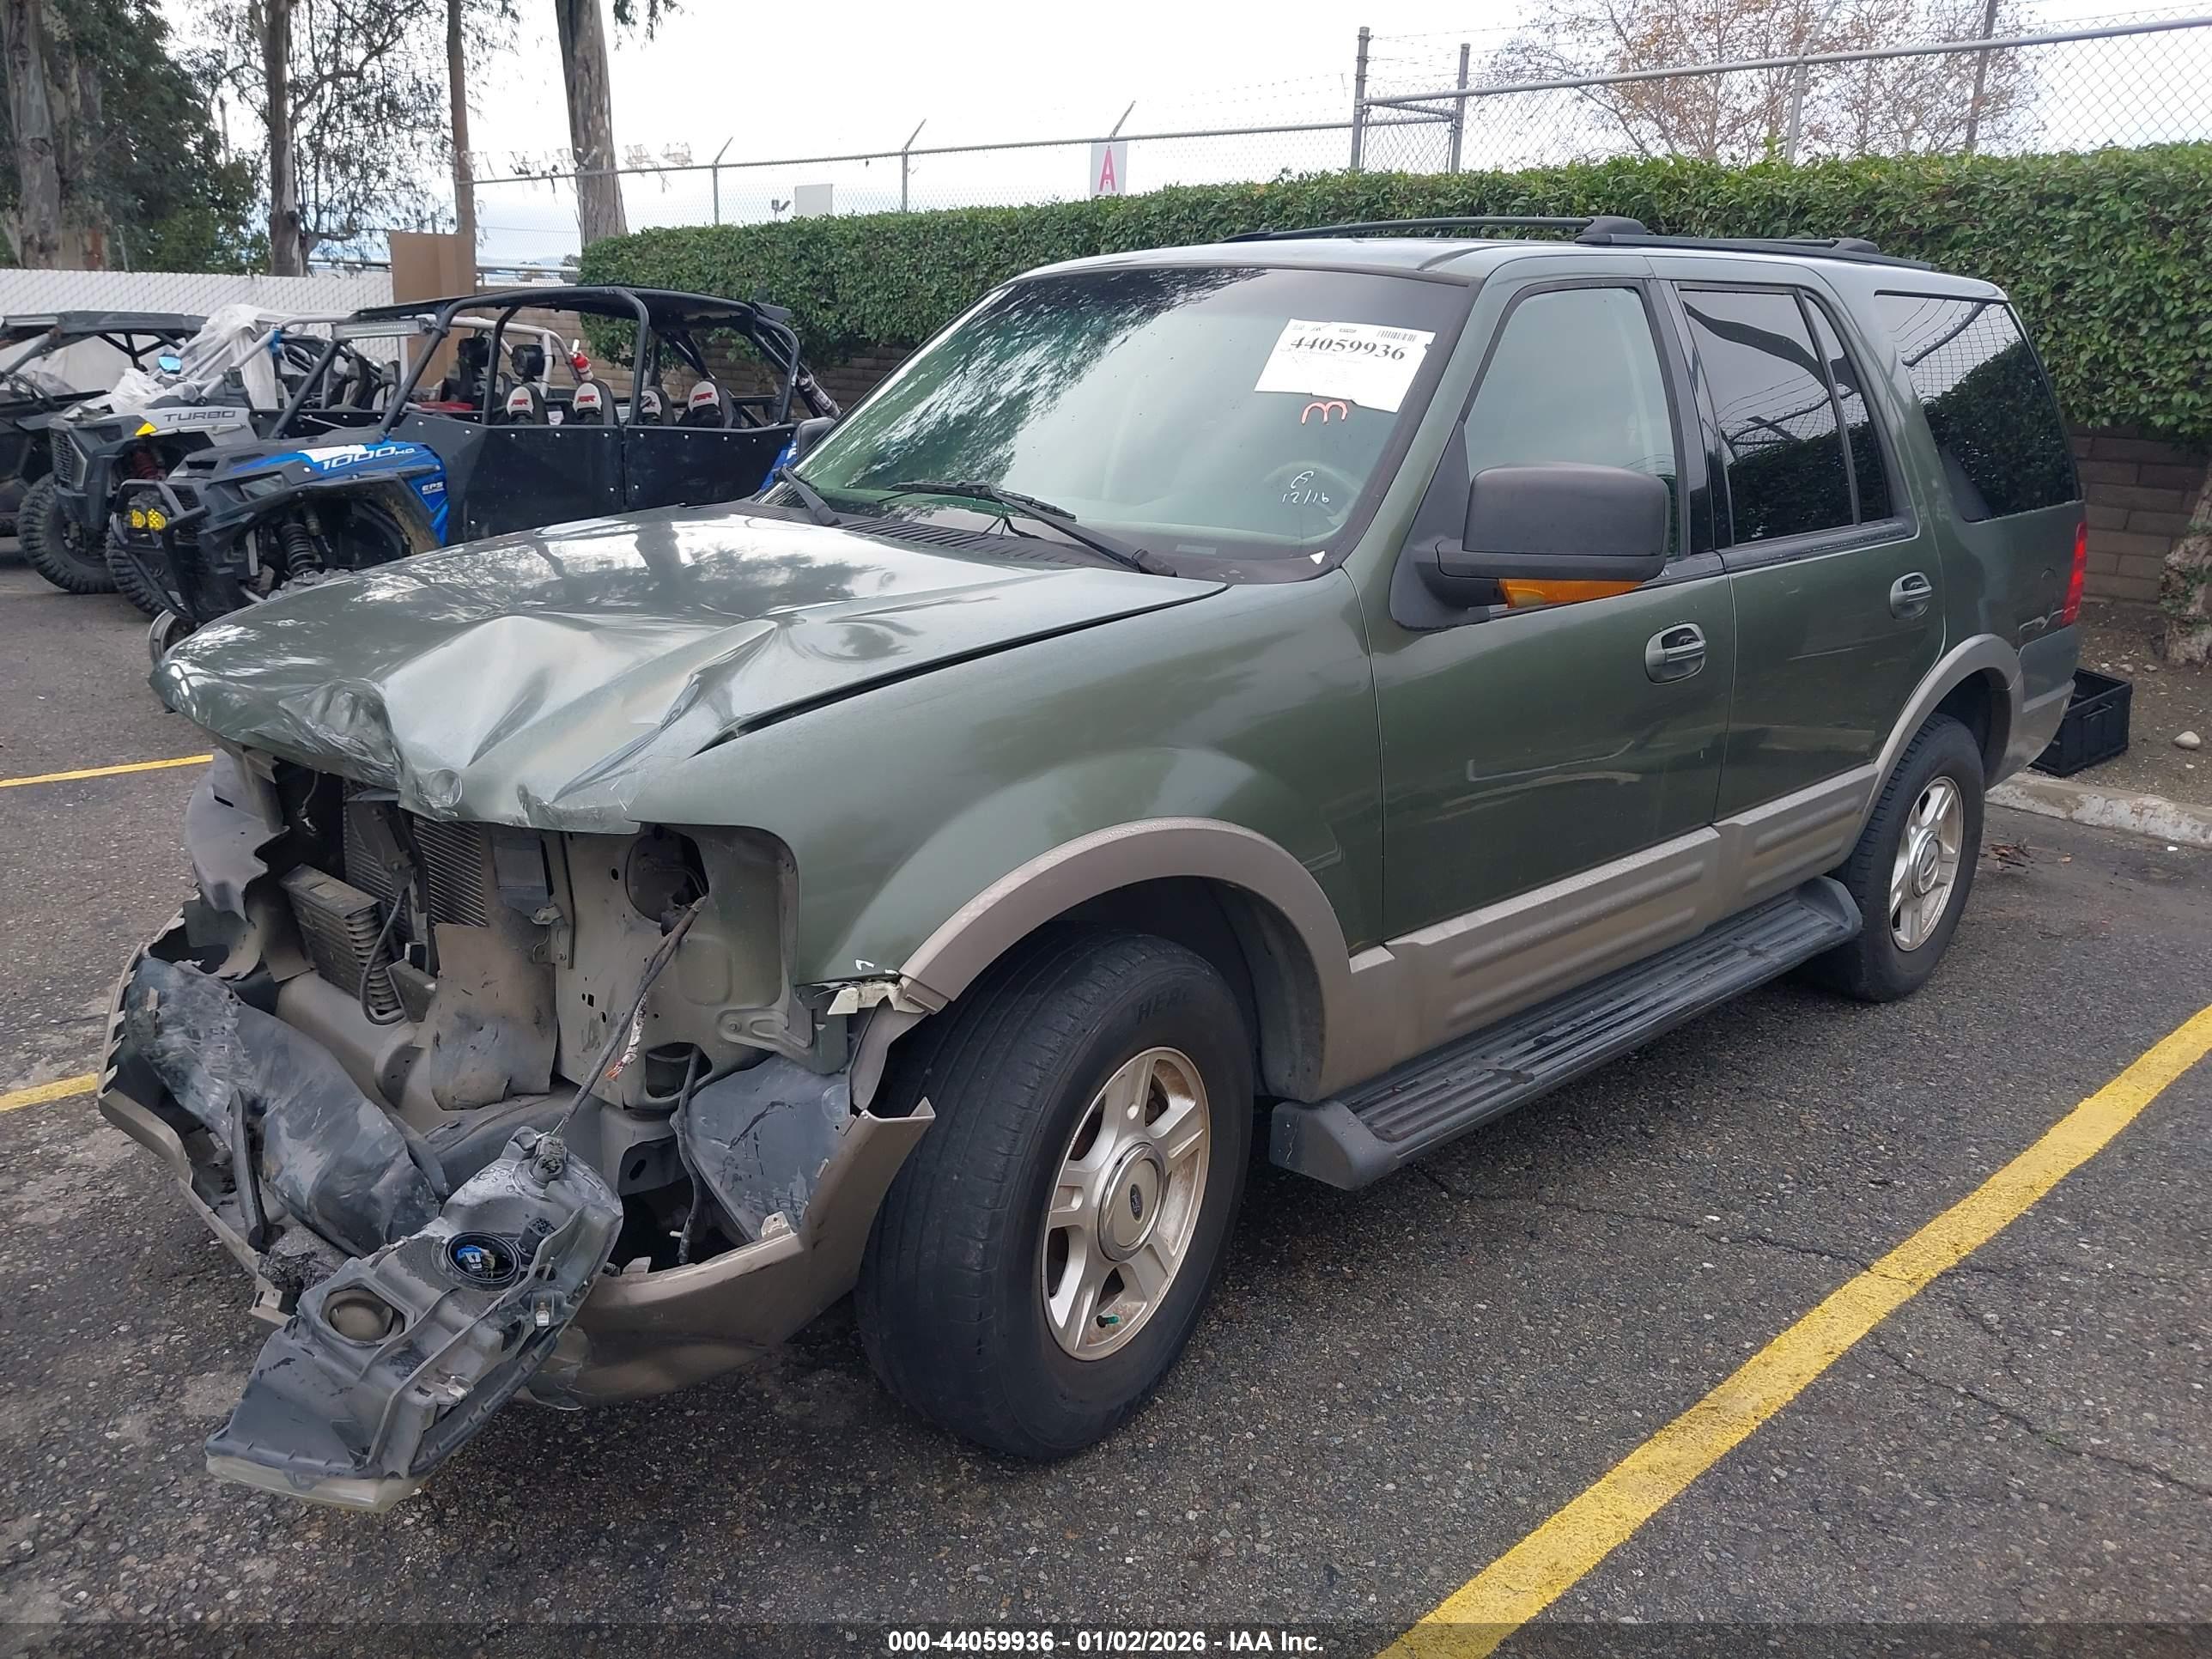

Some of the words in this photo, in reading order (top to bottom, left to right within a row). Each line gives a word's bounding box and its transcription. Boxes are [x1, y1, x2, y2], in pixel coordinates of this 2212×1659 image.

[1099, 149, 1116, 191] A
[1290, 336, 1408, 361] 44059936
[164, 410, 236, 422] TURBO
[323, 446, 397, 471] 1000
